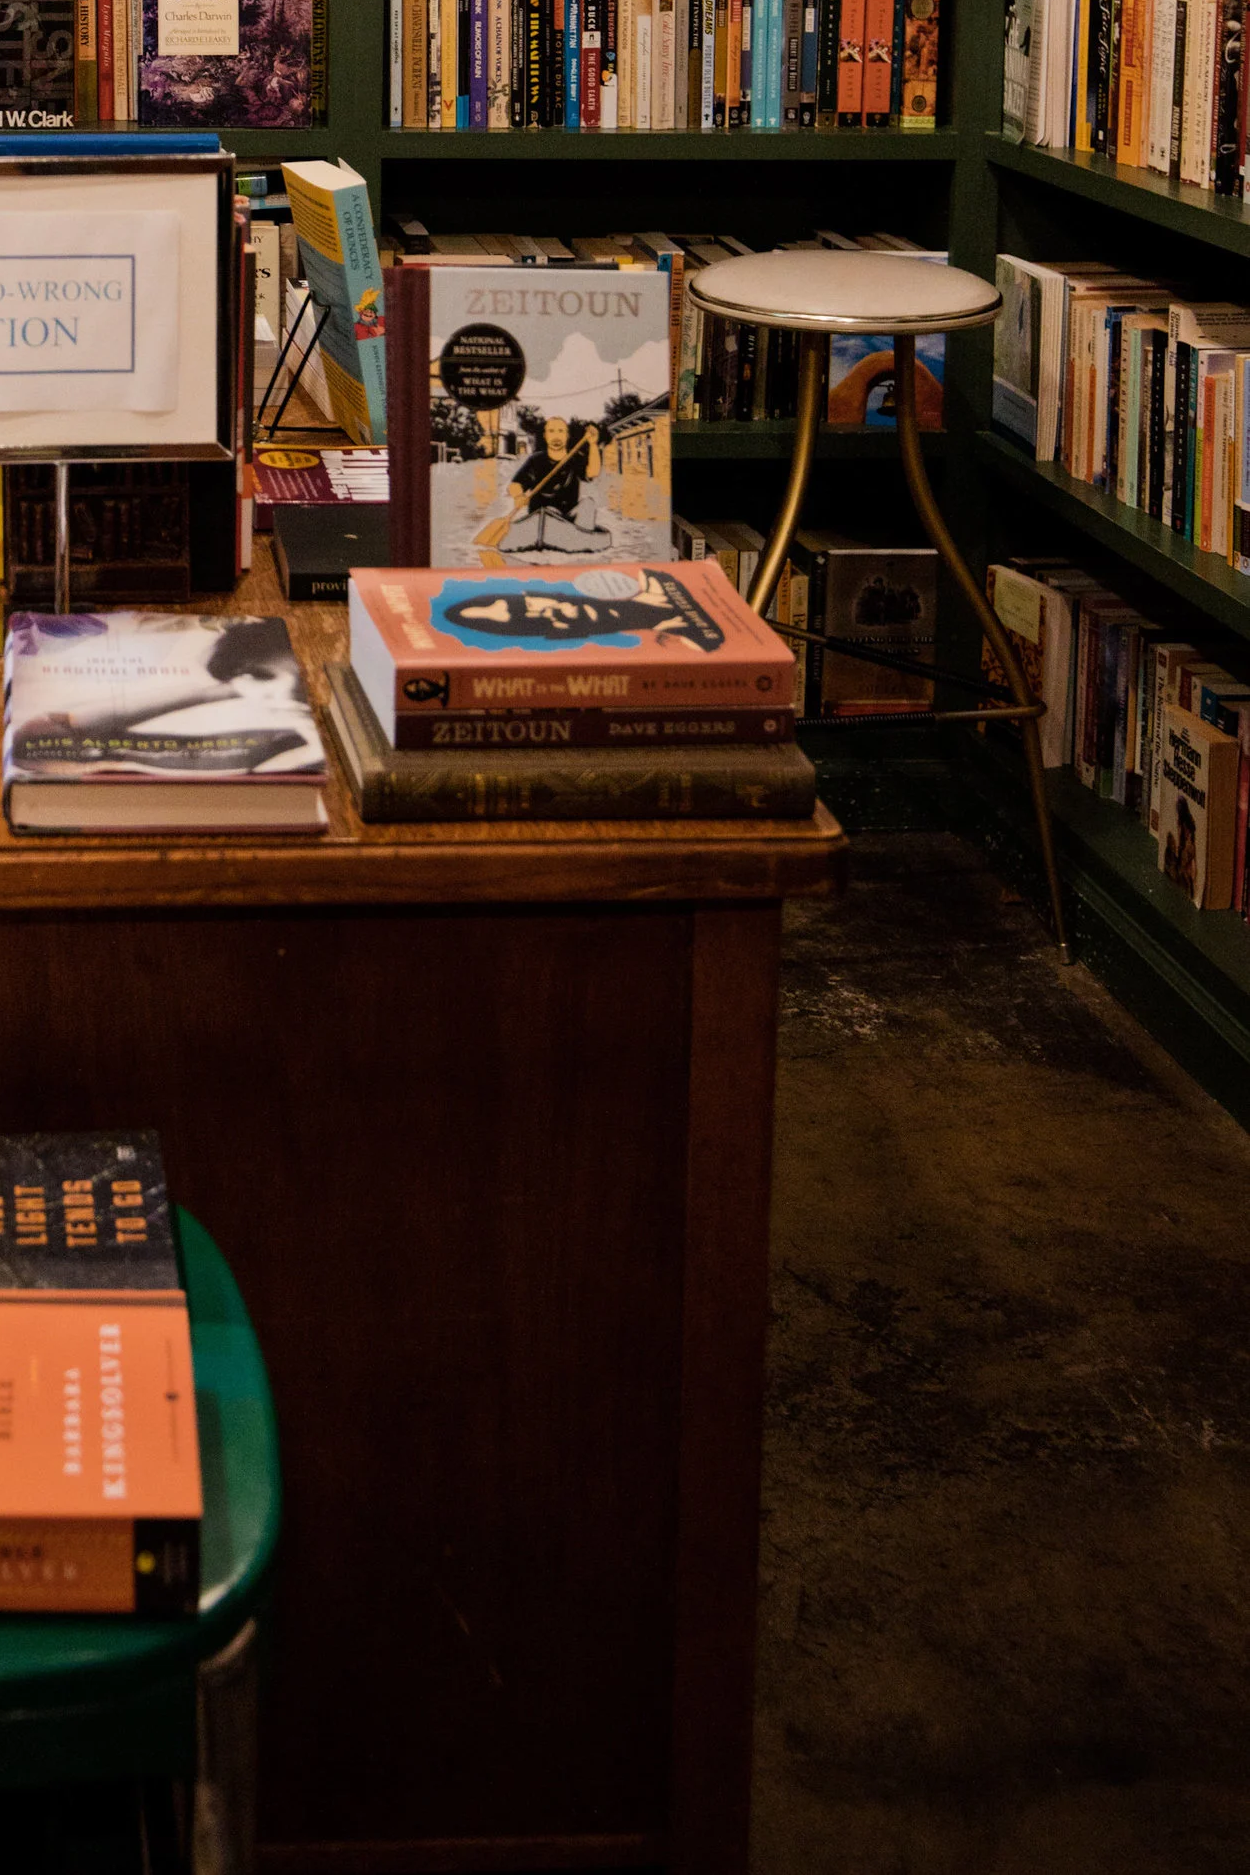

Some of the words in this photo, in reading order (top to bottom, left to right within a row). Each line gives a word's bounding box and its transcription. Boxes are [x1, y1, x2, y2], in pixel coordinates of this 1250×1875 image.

[5, 110, 27, 128] W.
[28, 110, 75, 128] Clark
[466, 290, 643, 317] ZEITOUN
[14, 1185, 49, 1247] LIGHT
[62, 1179, 98, 1249] TENDS
[111, 1179, 145, 1210] GO
[115, 1215, 149, 1244] TO
[62, 1367, 84, 1477] BARBARA
[98, 1322, 128, 1501] KINGSOLVER
